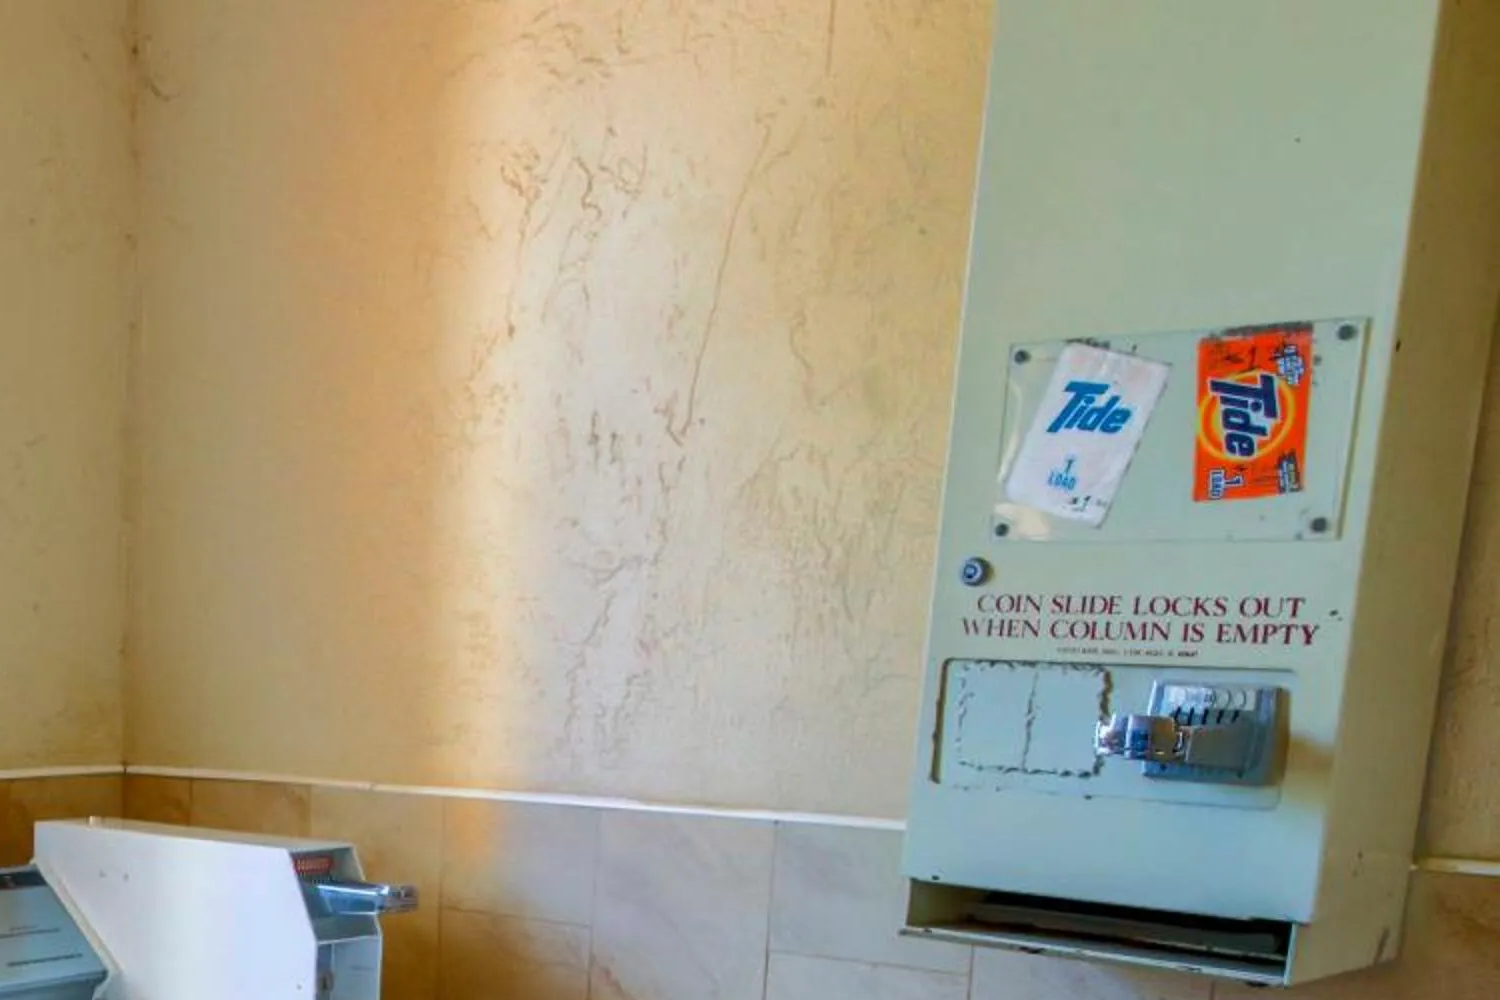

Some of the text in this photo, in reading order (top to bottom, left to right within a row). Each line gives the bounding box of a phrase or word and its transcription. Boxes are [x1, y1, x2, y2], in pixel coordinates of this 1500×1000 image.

[1046, 380, 1132, 434] Tide
[1209, 373, 1279, 457] Tide
[977, 594, 1306, 618] COIN SLIDE LOCKS OUT
[962, 618, 1321, 646] WHEN COLUMN IS EMPTY
